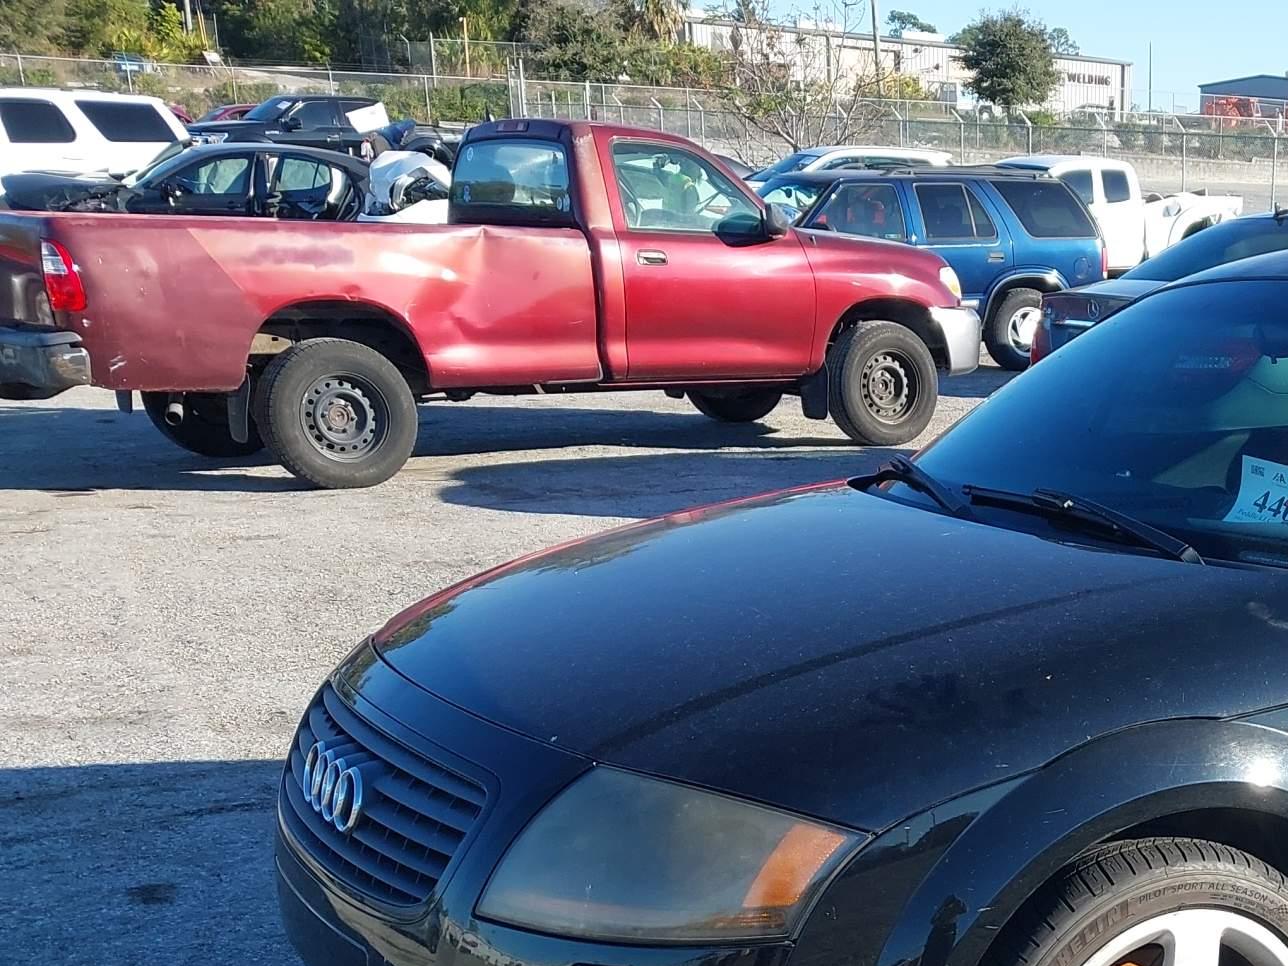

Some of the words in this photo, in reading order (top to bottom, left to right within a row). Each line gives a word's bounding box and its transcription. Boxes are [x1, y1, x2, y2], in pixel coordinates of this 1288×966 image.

[1066, 72, 1111, 86] WELDING
[1138, 887, 1167, 905] PILOT
[1170, 881, 1204, 894] SPORT
[1207, 881, 1226, 891] ALL
[1229, 884, 1268, 902] SEASON
